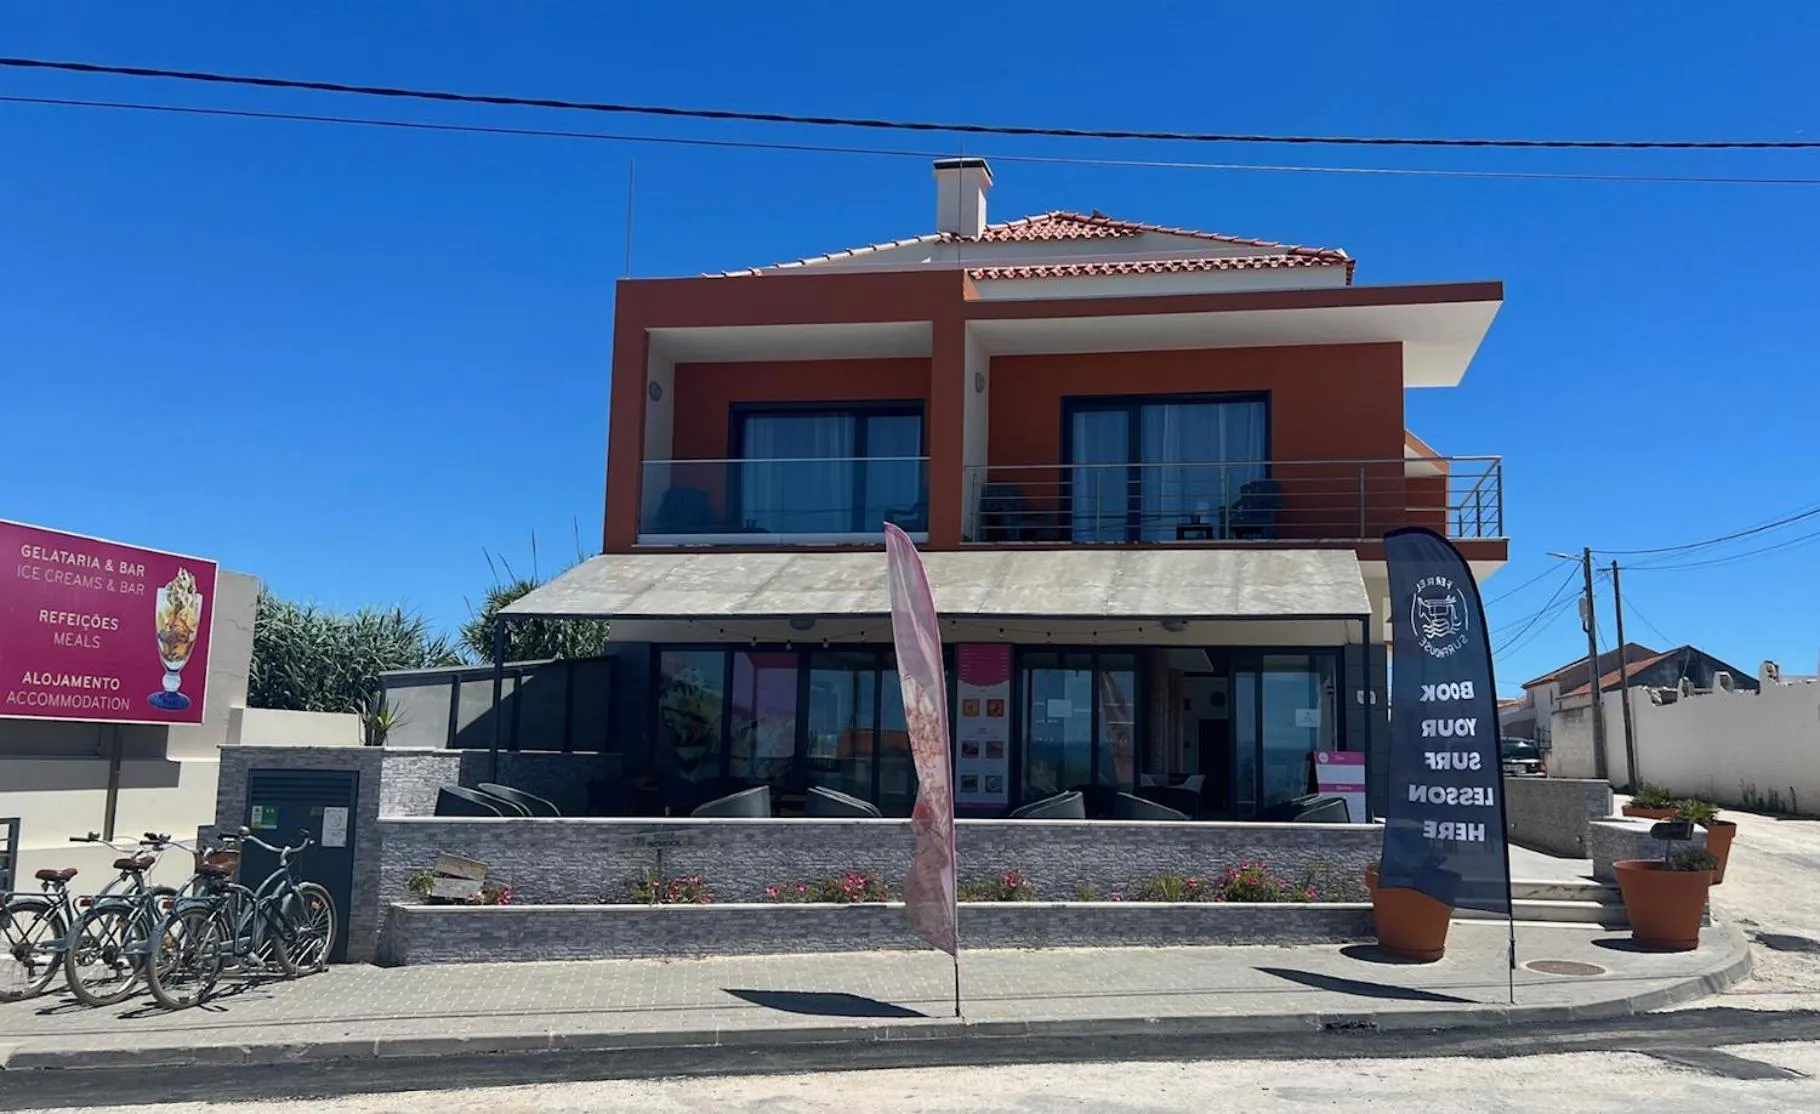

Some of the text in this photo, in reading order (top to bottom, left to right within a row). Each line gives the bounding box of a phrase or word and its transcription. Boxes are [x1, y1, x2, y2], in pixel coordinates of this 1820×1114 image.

[21, 544, 145, 577] GELATARIA & BAR
[17, 565, 145, 596] ICE CREAMS & BAR
[39, 609, 119, 631] REFEIÇÕES
[53, 632, 101, 649] MEALS
[22, 672, 120, 690] ALOJAMENTO
[6, 691, 130, 710] ACCOMMODATION
